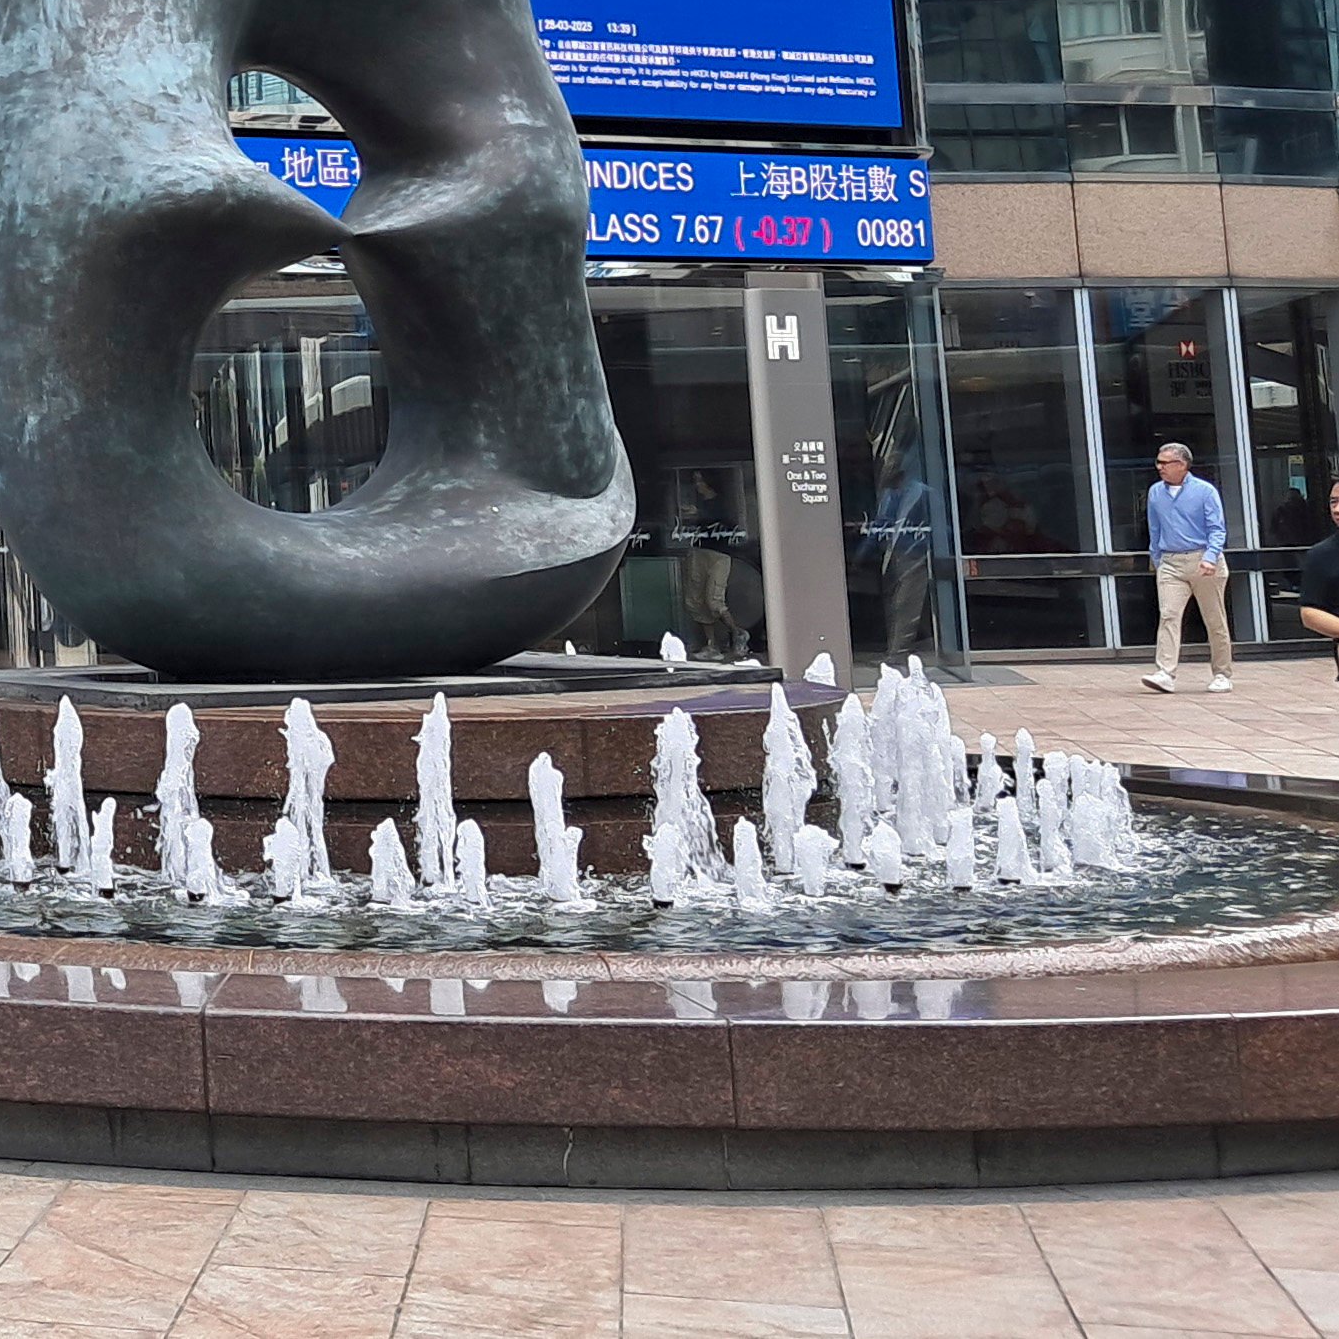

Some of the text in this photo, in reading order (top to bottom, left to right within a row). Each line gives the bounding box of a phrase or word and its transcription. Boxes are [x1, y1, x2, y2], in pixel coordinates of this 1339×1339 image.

[585, 161, 694, 192] INDICES
[729, 161, 899, 202] 上海B股指數
[586, 212, 660, 243] LASS
[671, 214, 723, 244] 7.67
[857, 218, 926, 248] 00881
